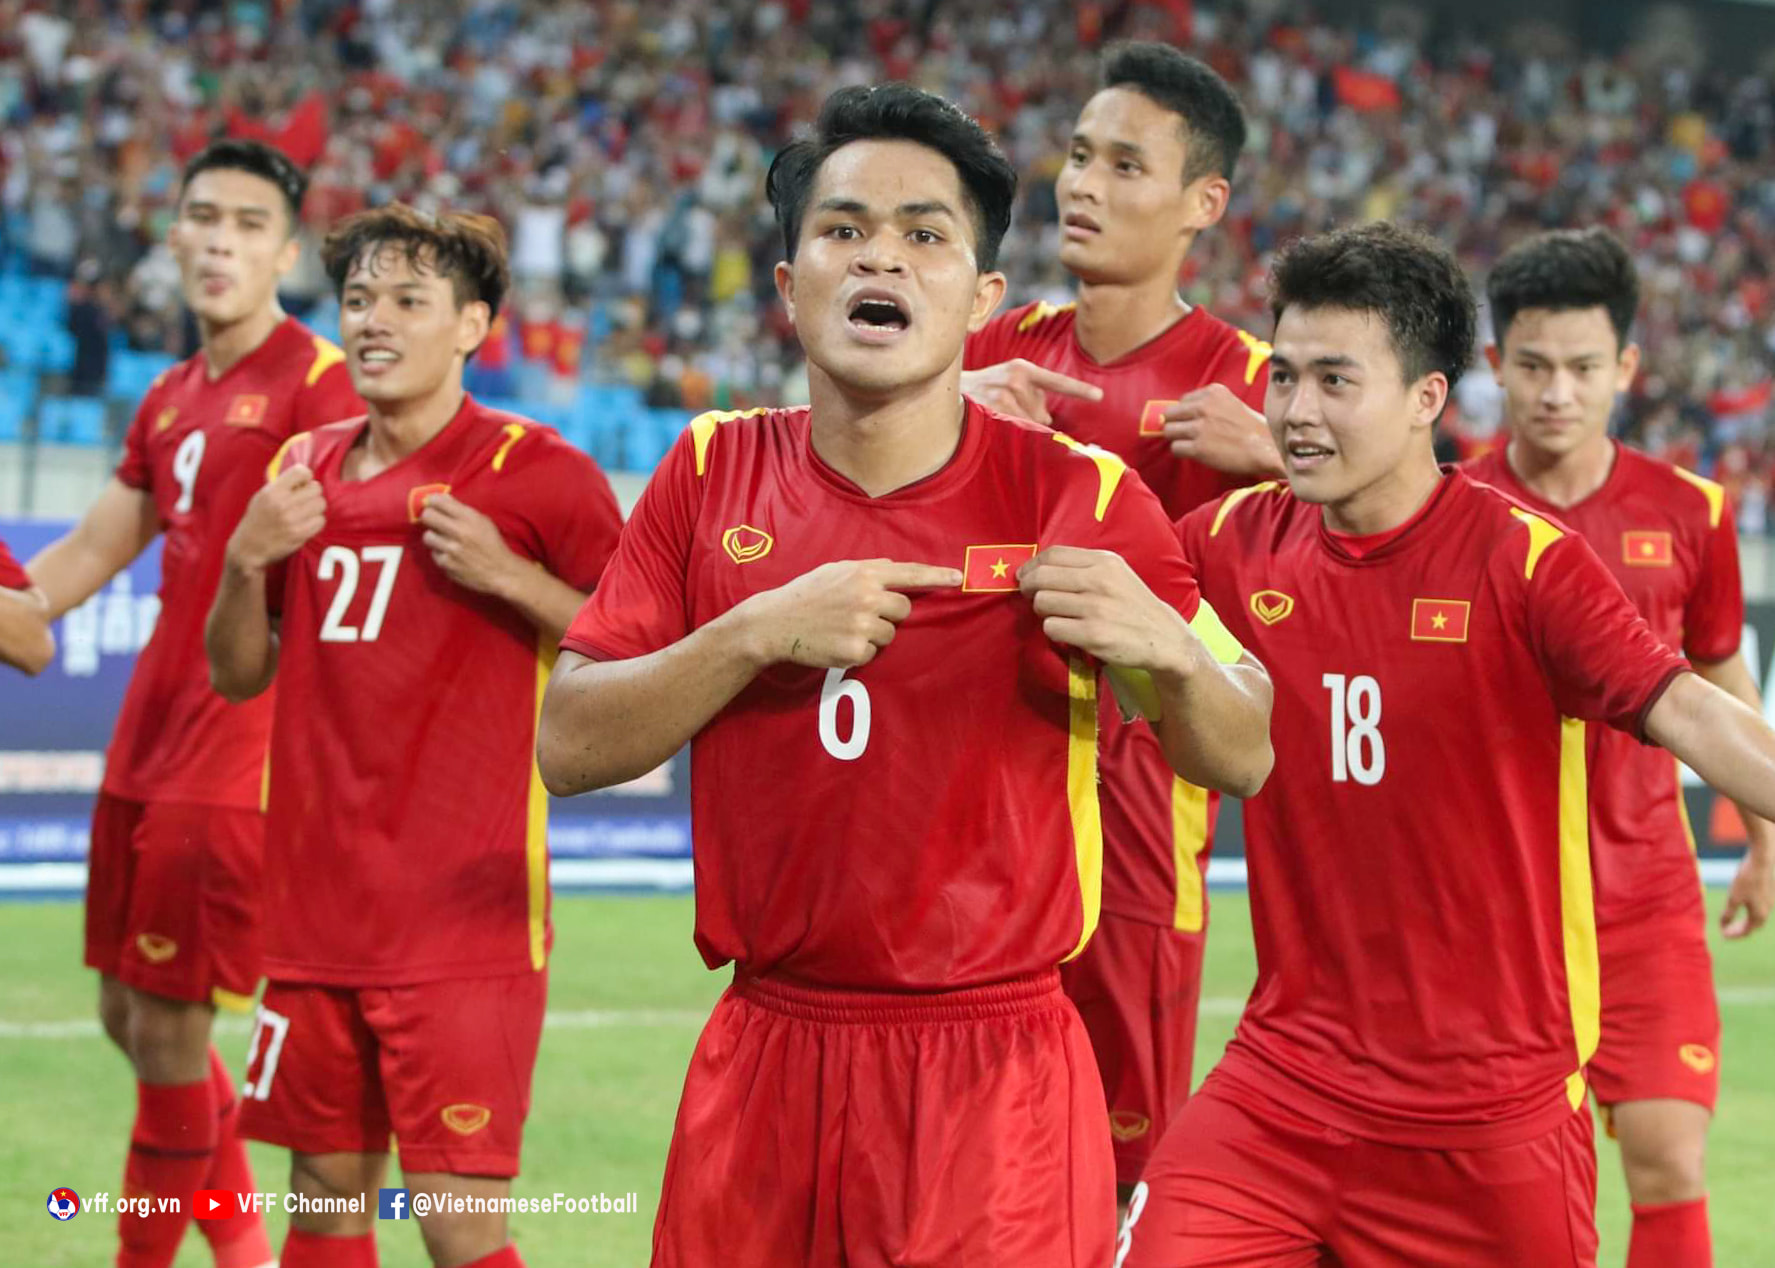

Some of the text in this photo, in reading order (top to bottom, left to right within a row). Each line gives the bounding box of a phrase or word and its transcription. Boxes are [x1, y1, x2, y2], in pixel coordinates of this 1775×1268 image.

[173, 430, 206, 513] 9
[317, 545, 403, 643] 27
[818, 666, 871, 760] 6
[1322, 673, 1385, 785] 18
